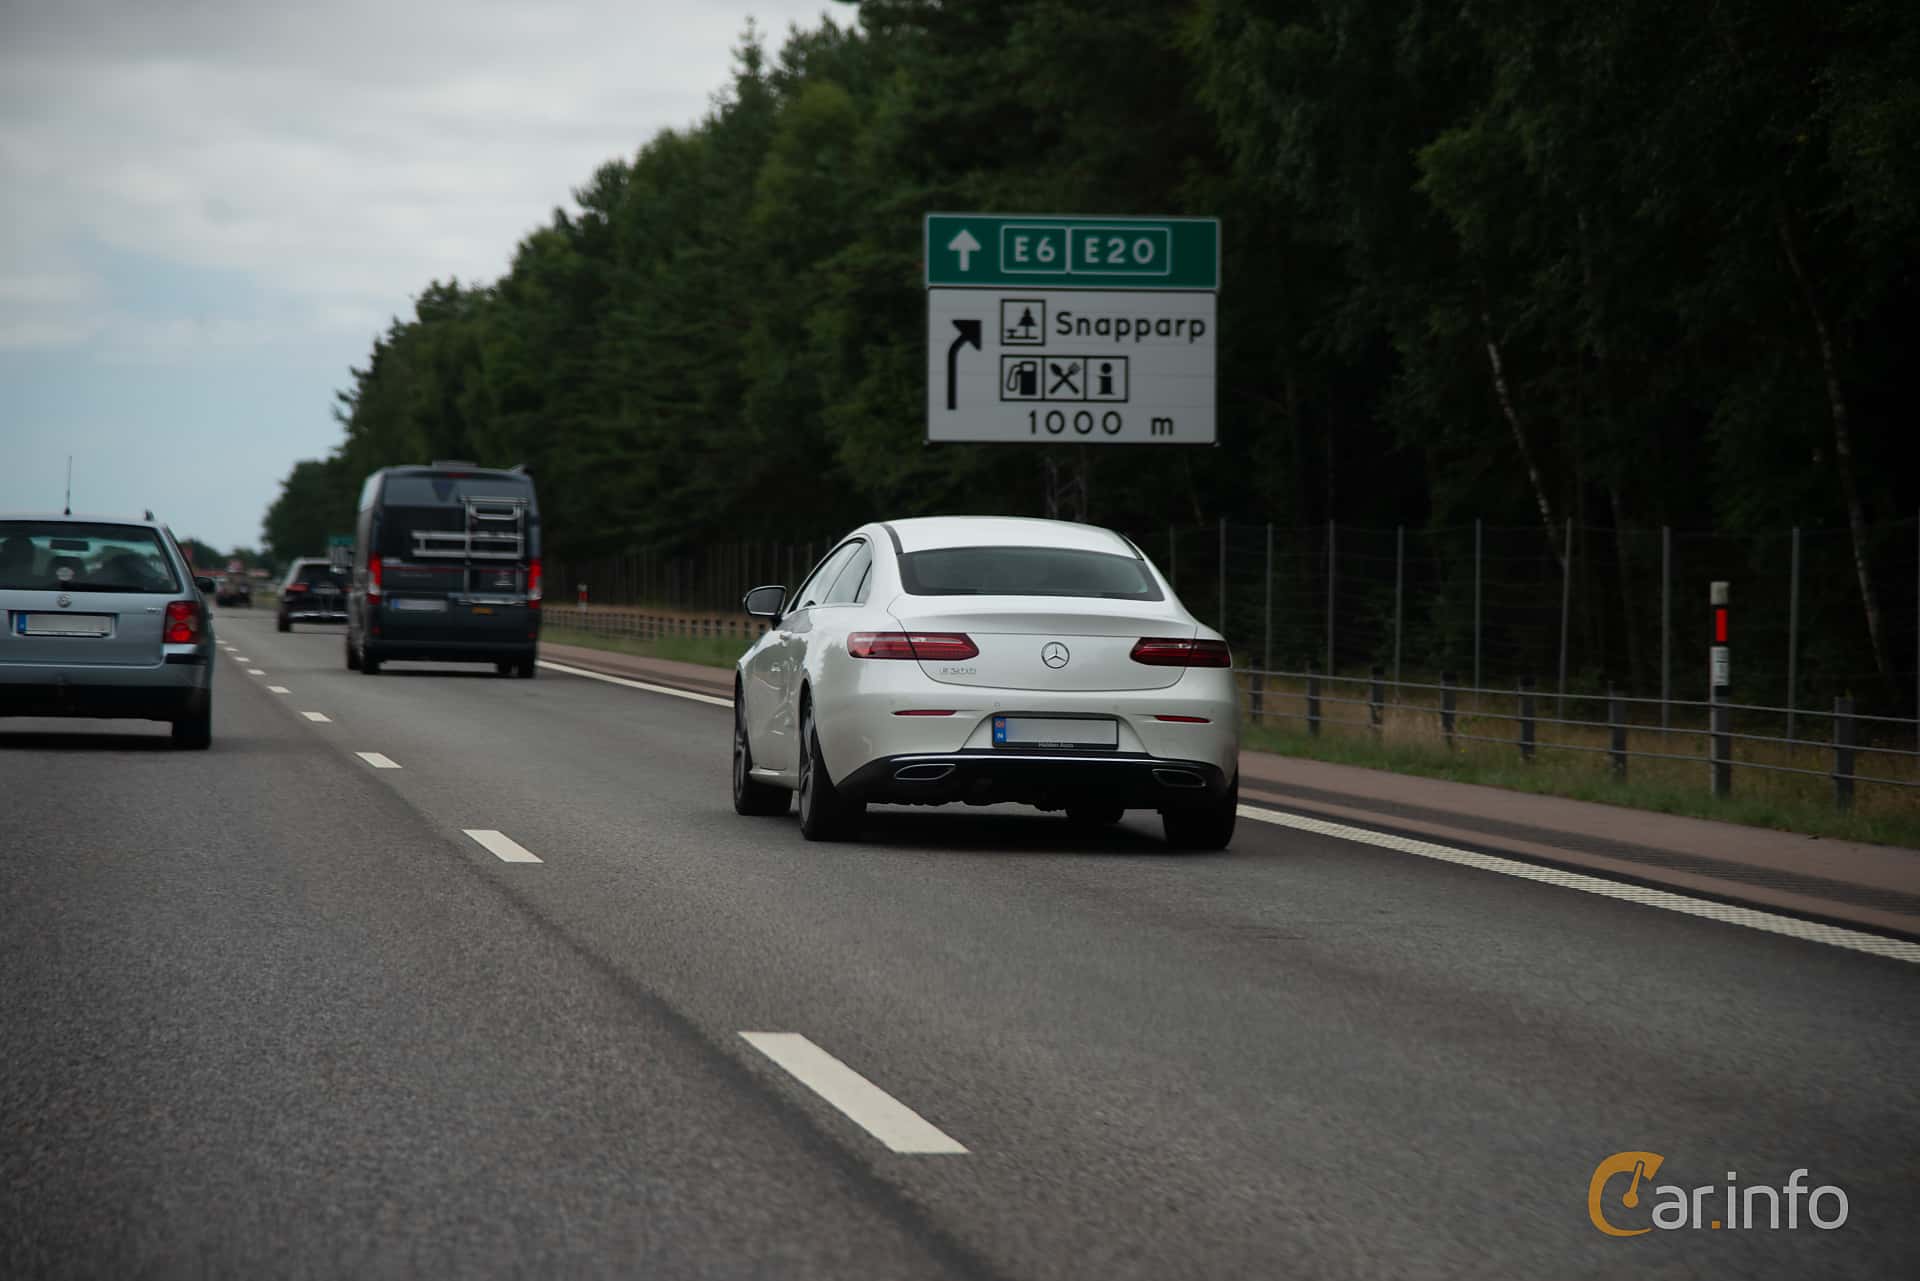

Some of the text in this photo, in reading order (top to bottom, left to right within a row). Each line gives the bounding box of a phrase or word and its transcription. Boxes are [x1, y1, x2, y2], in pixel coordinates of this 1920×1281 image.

[1014, 236, 1056, 264] E6
[1084, 237, 1155, 264] E20
[1055, 311, 1206, 343] Snapparp
[1028, 410, 1174, 436] 1000 m
